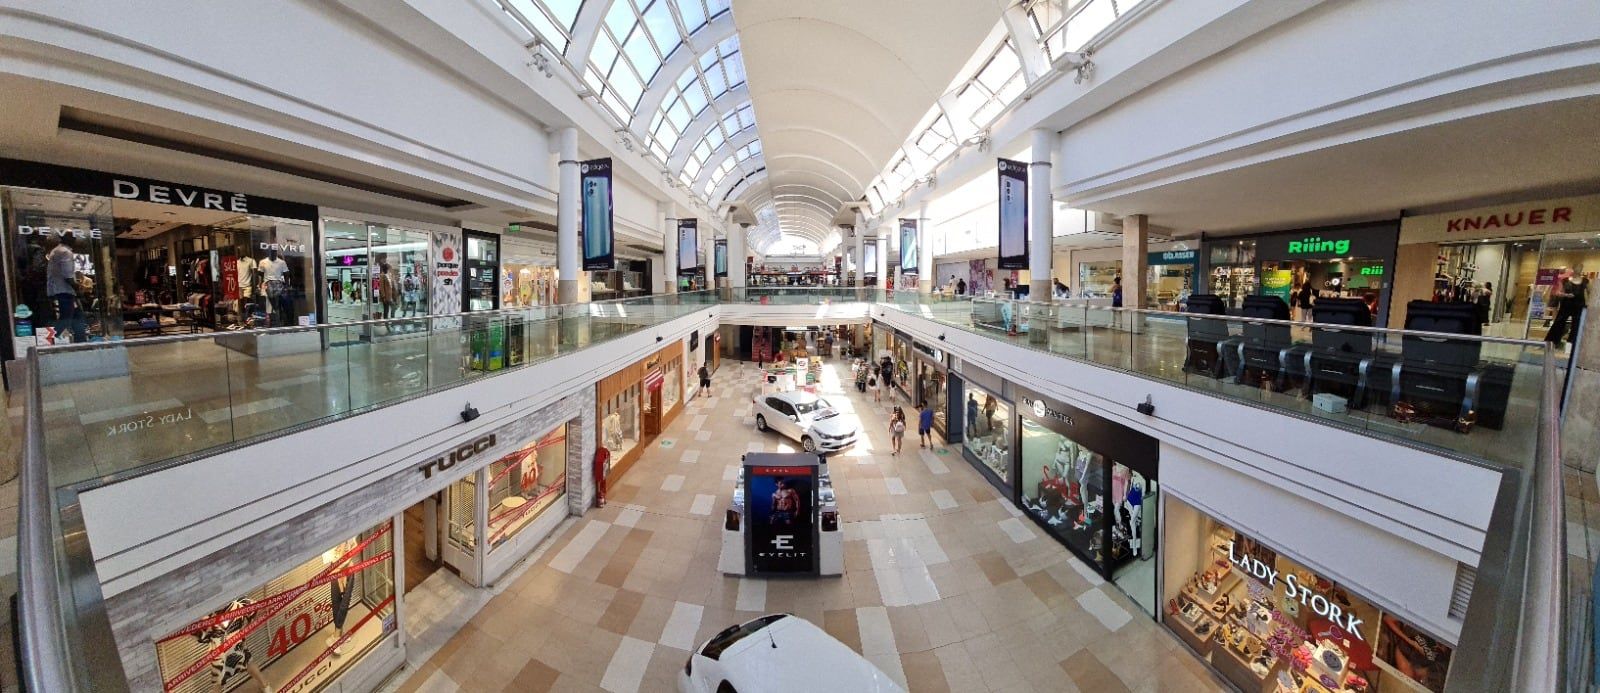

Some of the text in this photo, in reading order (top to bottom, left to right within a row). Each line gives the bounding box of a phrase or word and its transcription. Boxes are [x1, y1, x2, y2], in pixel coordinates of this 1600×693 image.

[1447, 207, 1572, 233] KNAUER
[1288, 236, 1351, 255] Riiing
[223, 260, 236, 272] SALE
[1360, 265, 1384, 275] Riii
[418, 433, 496, 479] TUCCI
[520, 467, 537, 491] 40
[1228, 540, 1364, 641] LADY STORK
[219, 603, 266, 622] ARRIVEDERCI
[284, 597, 315, 621] HASTA
[267, 612, 312, 658] 40
[167, 649, 221, 690] ARRIVEDERCI
[223, 611, 267, 649] ARRIVEDERCI
